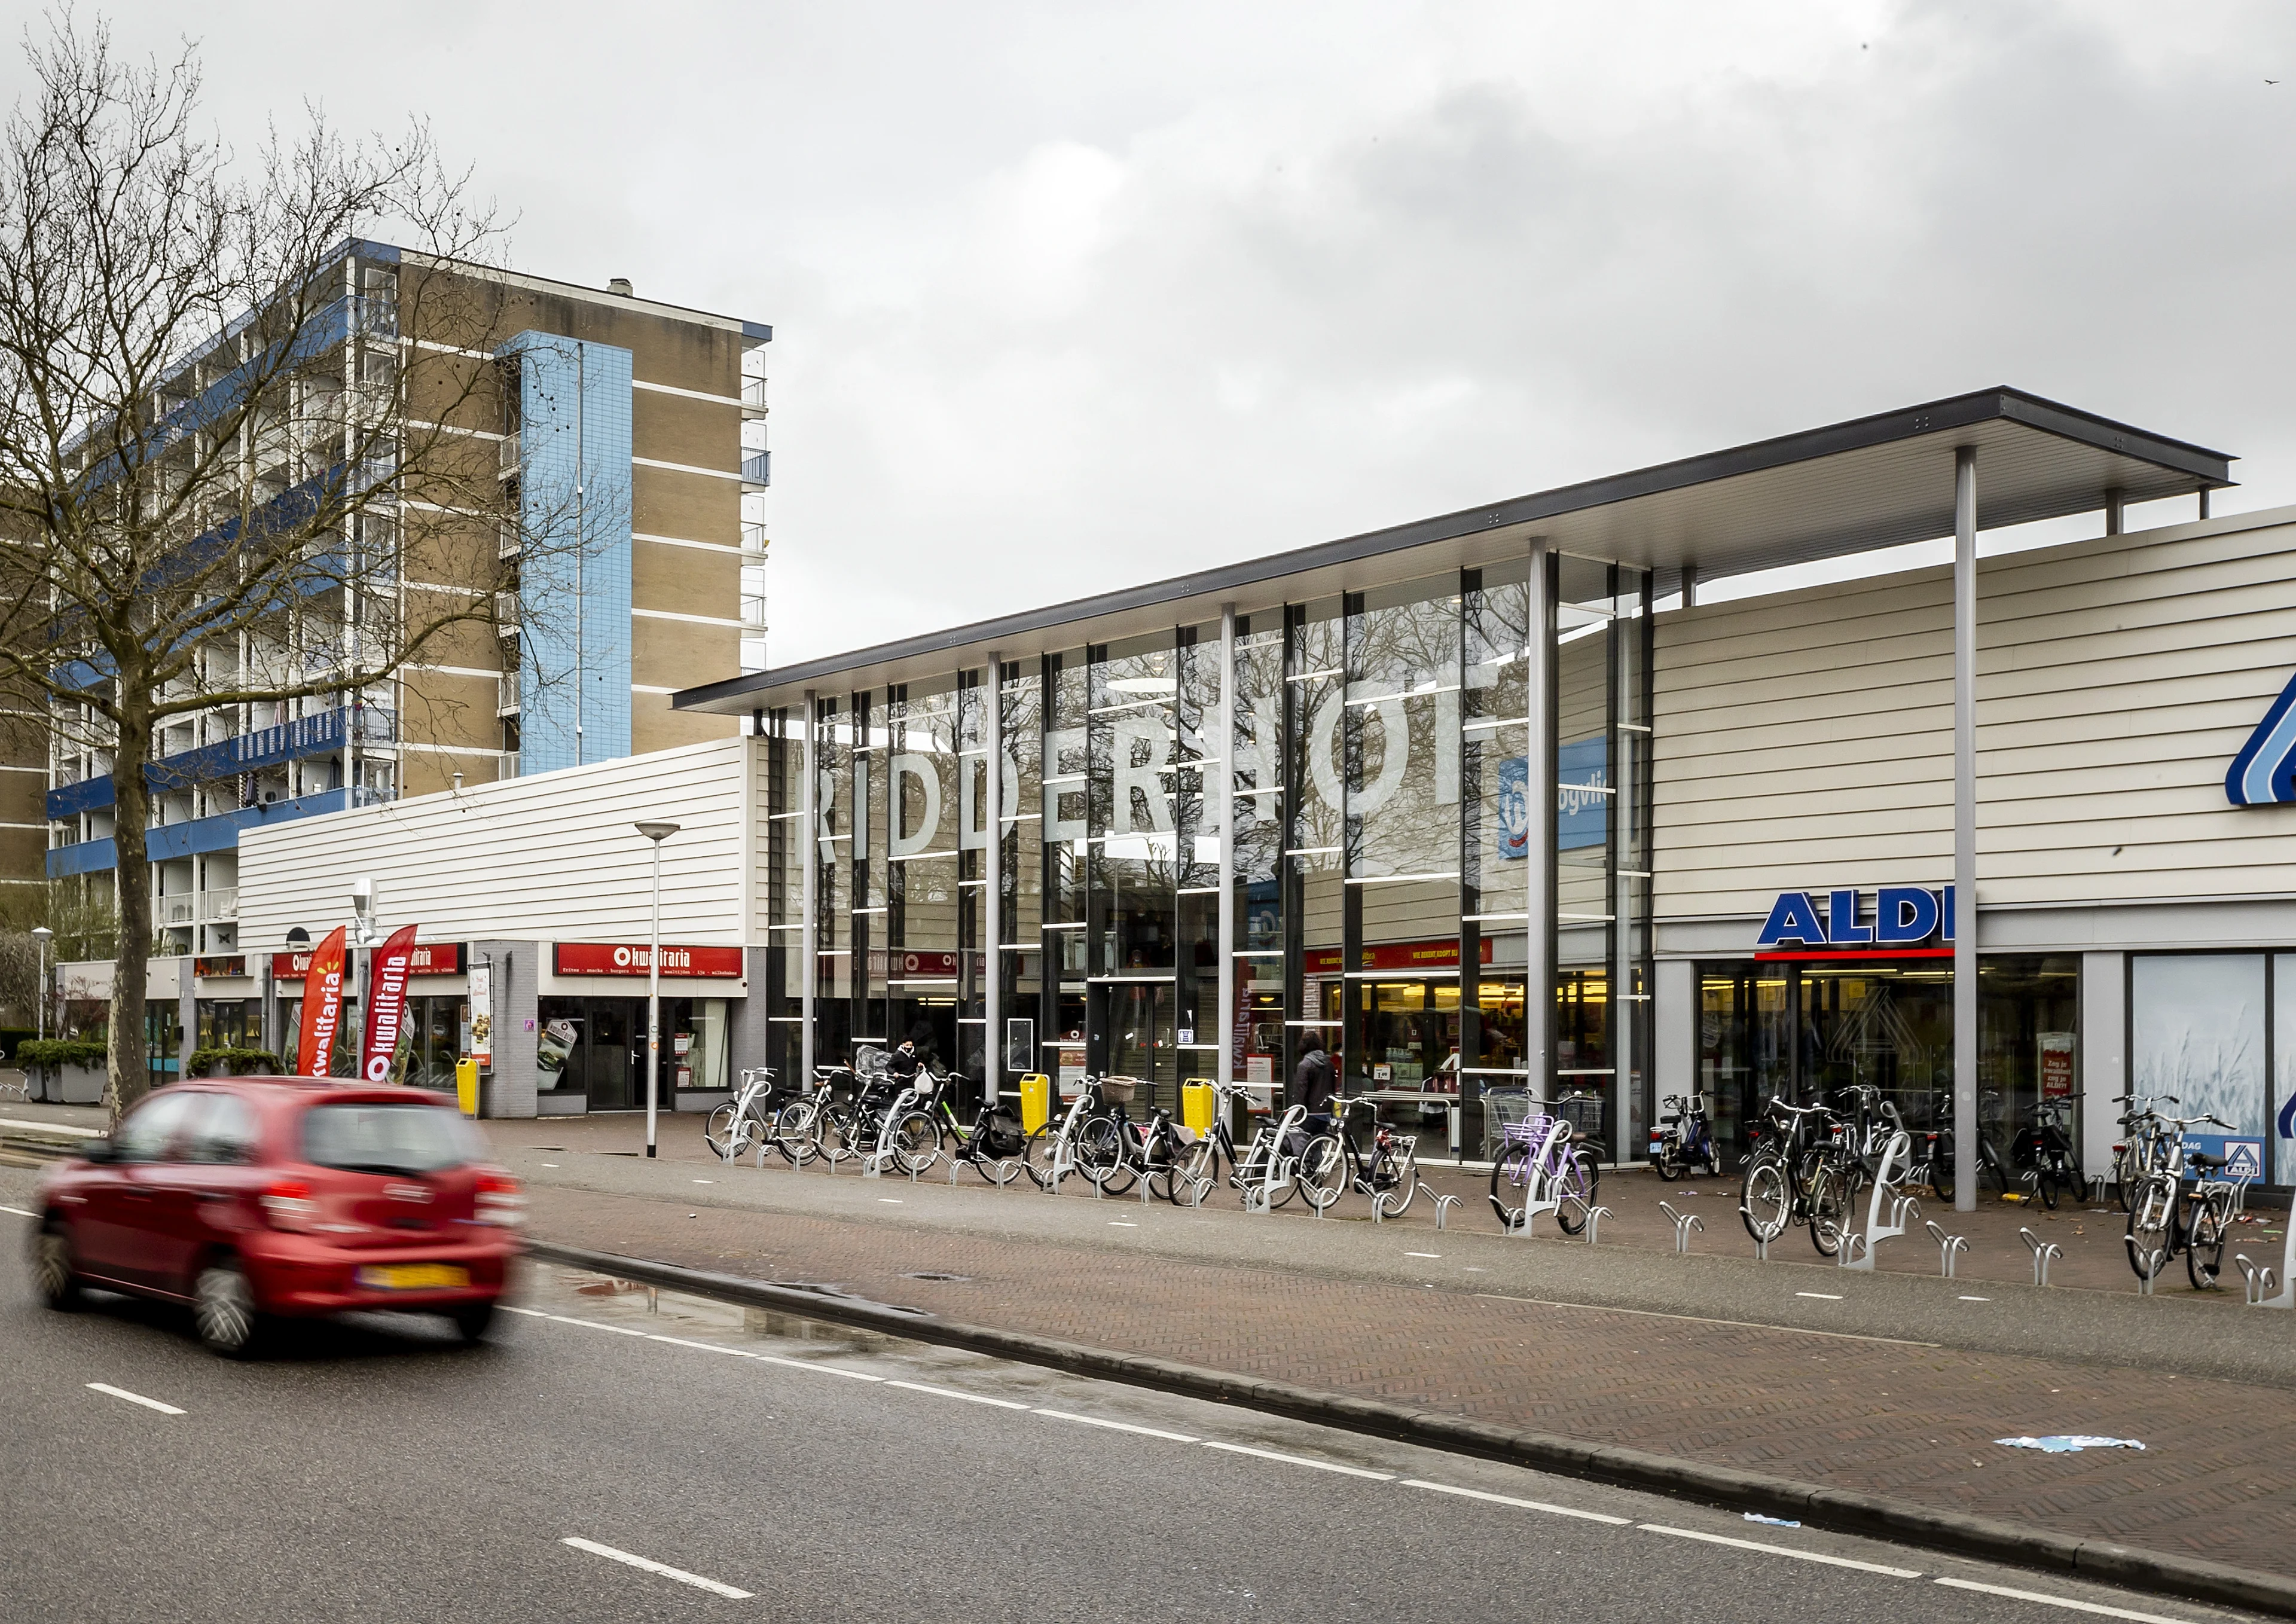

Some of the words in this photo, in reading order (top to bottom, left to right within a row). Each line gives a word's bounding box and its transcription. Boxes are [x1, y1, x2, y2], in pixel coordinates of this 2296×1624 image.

[795, 662, 1498, 865] RIDDERHOF
[370, 957, 407, 1053] kwalitaria
[632, 947, 690, 967] kwitaria
